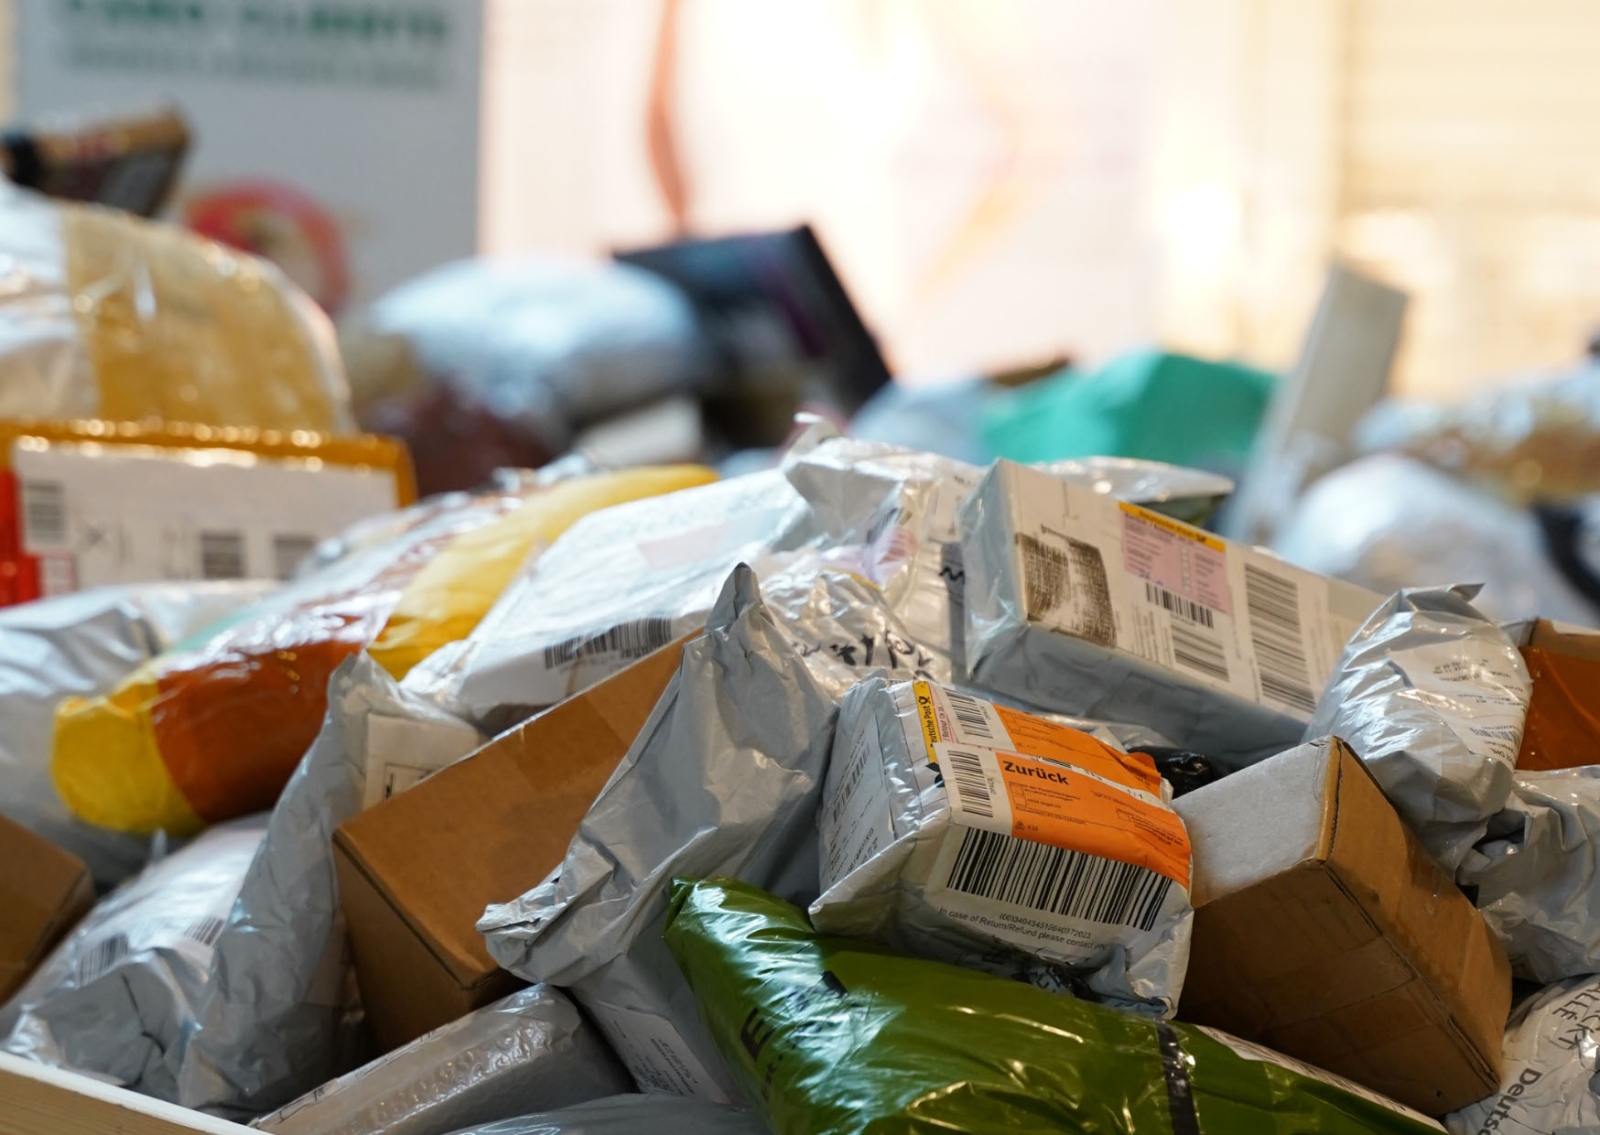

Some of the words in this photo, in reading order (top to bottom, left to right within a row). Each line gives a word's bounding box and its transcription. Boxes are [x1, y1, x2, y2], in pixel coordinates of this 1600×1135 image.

[924, 705, 933, 720] Post
[1003, 760, 1070, 786] Zurück
[949, 909, 969, 921] case
[970, 914, 980, 922] of
[979, 917, 1038, 938] Return/Refund
[1038, 931, 1066, 945] please
[1066, 935, 1095, 950] contact
